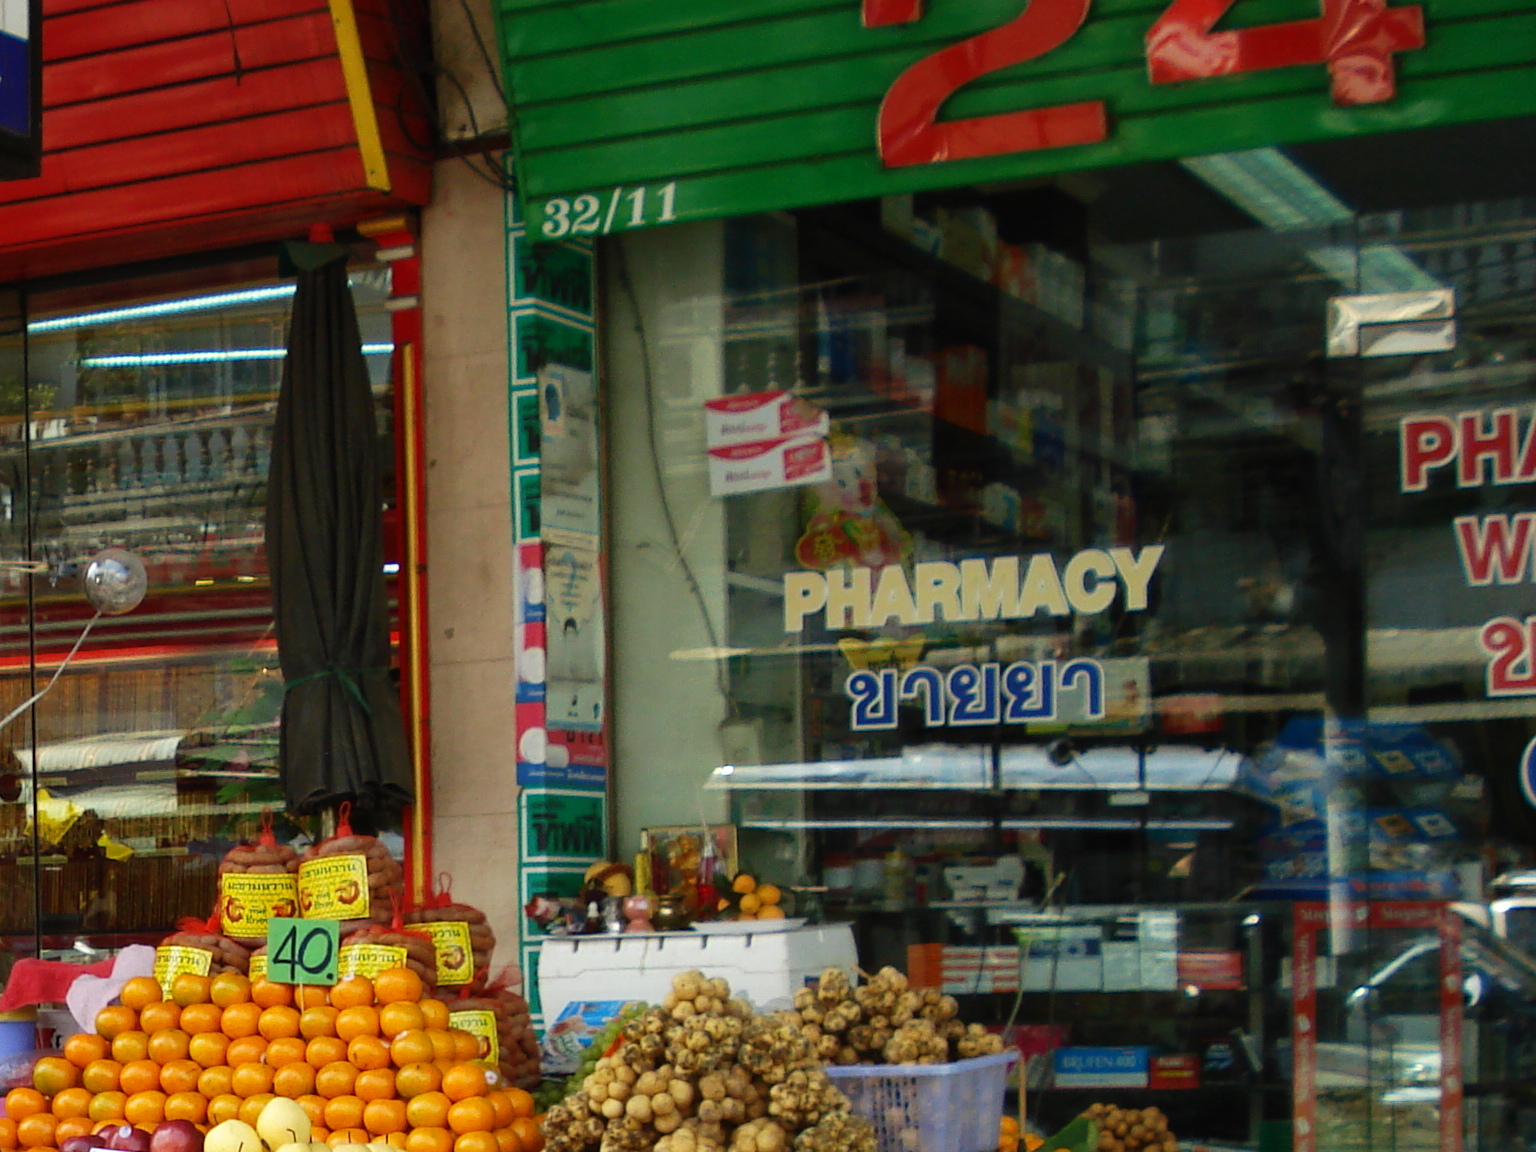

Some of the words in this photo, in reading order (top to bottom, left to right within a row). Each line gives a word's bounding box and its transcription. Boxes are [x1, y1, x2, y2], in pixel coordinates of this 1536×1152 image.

[540, 182, 679, 238] 32/11
[1400, 407, 1536, 492] PH
[1453, 512, 1536, 587] W
[782, 544, 1166, 633] PHARMACY
[845, 657, 1107, 731] ขายยา
